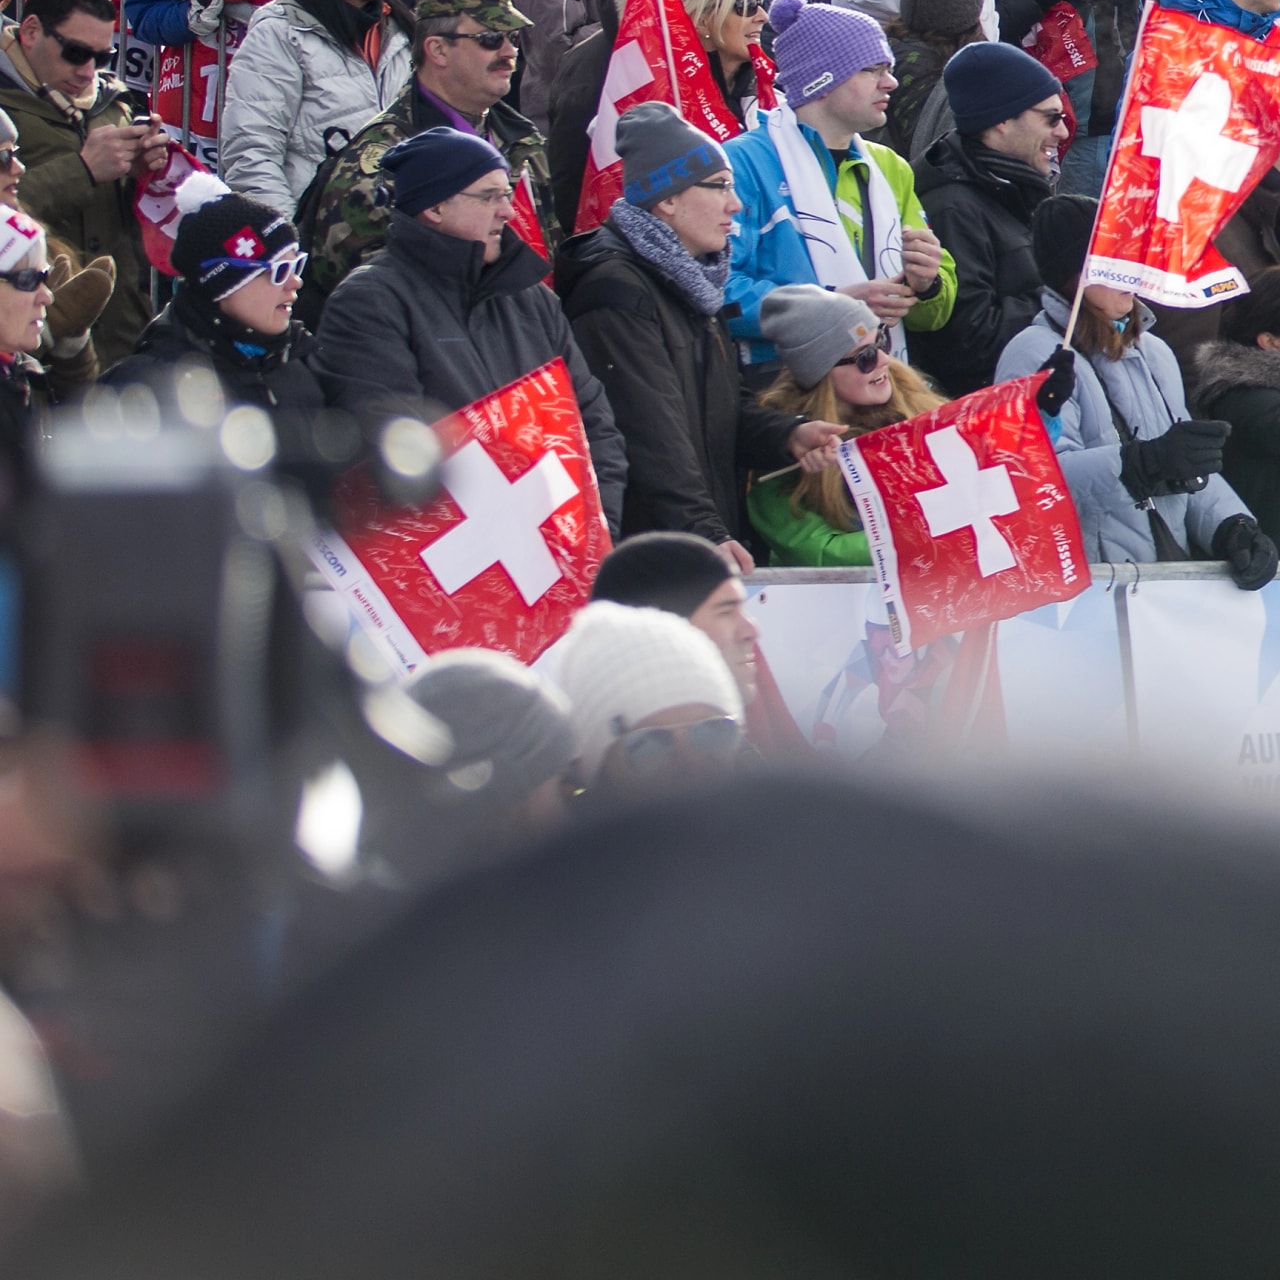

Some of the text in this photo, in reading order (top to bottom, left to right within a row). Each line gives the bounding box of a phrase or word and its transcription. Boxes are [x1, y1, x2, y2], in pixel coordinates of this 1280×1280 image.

[694, 88, 731, 140] swissski
[840, 441, 861, 484] isscom
[862, 497, 881, 541] RAIFFEISEN
[1050, 523, 1079, 586] swissski
[352, 588, 385, 629] RAIFFEISEN
